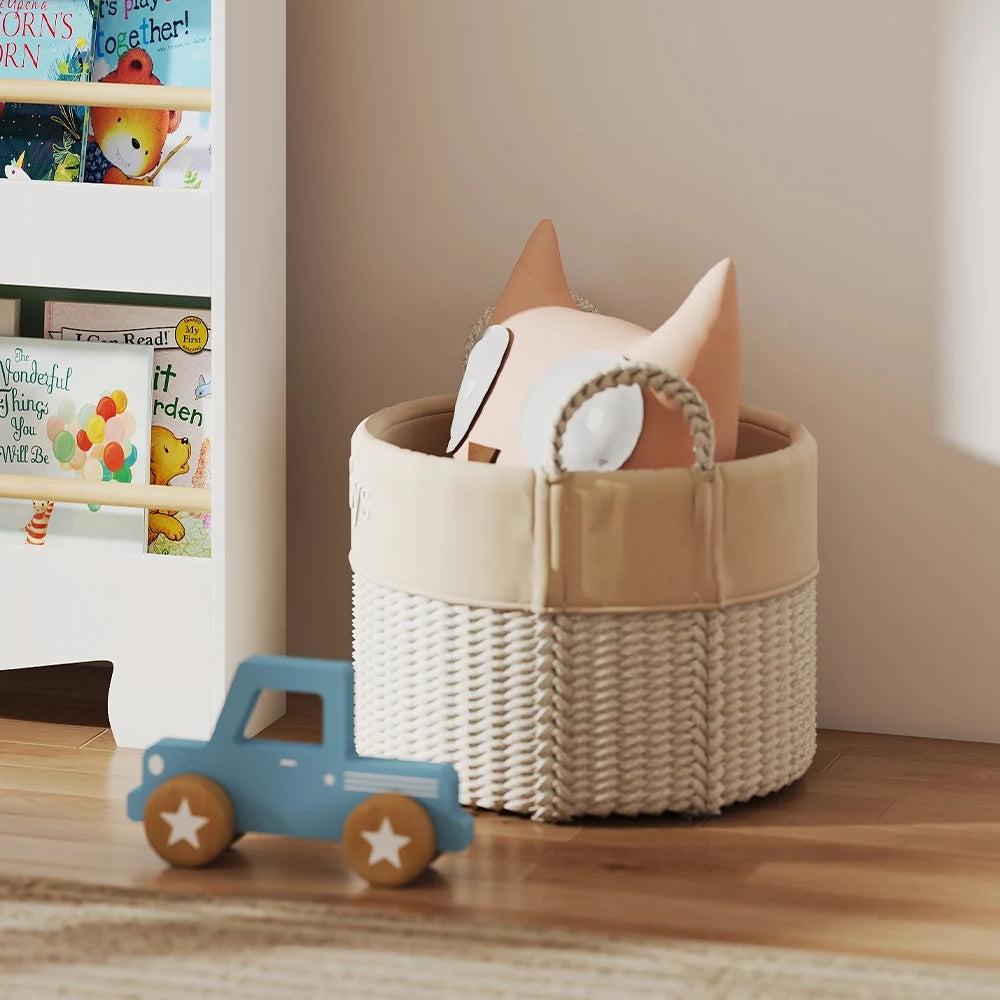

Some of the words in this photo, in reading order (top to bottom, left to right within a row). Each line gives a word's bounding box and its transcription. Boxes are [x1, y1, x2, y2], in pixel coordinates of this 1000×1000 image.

[40, 0, 48, 11] a
[96, 10, 189, 59] together!
[185, 325, 199, 336] My
[122, 331, 168, 346] Read!
[183, 335, 201, 344] First
[14, 347, 30, 362] The
[153, 397, 203, 426] rden
[10, 416, 37, 441] You
[31, 445, 50, 464] Be
